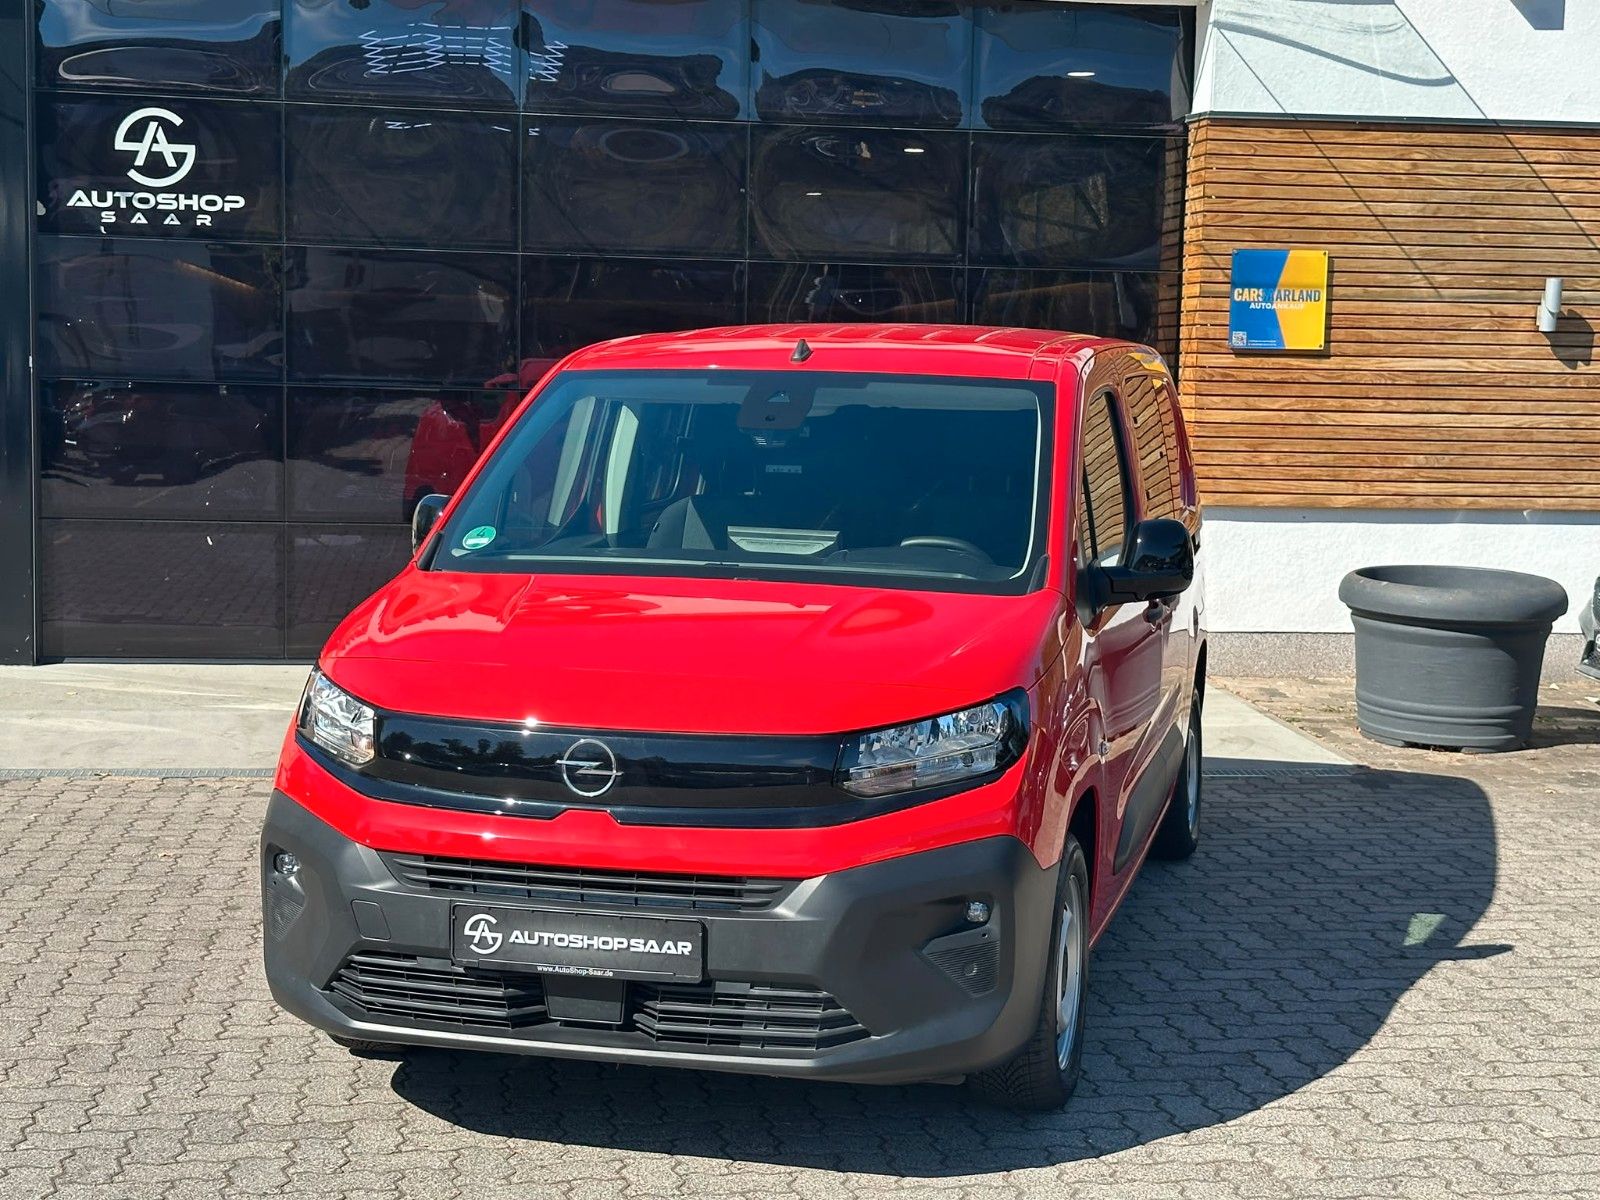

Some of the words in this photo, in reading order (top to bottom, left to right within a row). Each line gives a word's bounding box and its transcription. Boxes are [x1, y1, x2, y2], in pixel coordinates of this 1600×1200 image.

[66, 189, 246, 212] AUTOSHOP
[100, 210, 213, 226] SAAR
[476, 527, 487, 538] 4
